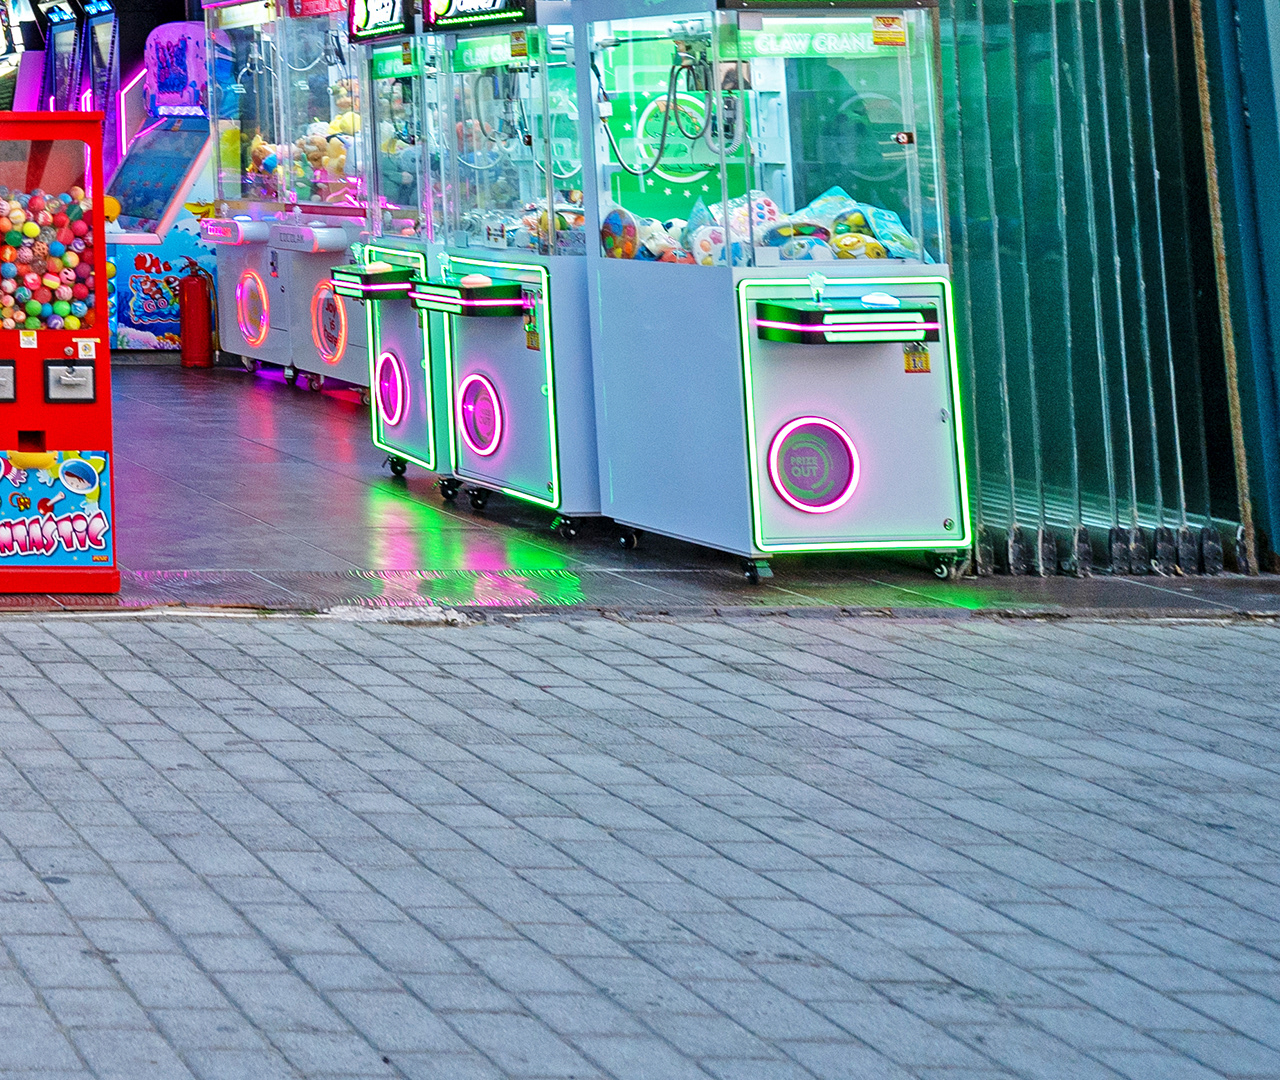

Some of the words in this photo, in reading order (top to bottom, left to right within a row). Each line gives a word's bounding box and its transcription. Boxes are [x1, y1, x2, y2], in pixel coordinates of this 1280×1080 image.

[491, 43, 512, 63] CRA
[753, 33, 811, 55] CLAW
[792, 466, 818, 477] OUT
